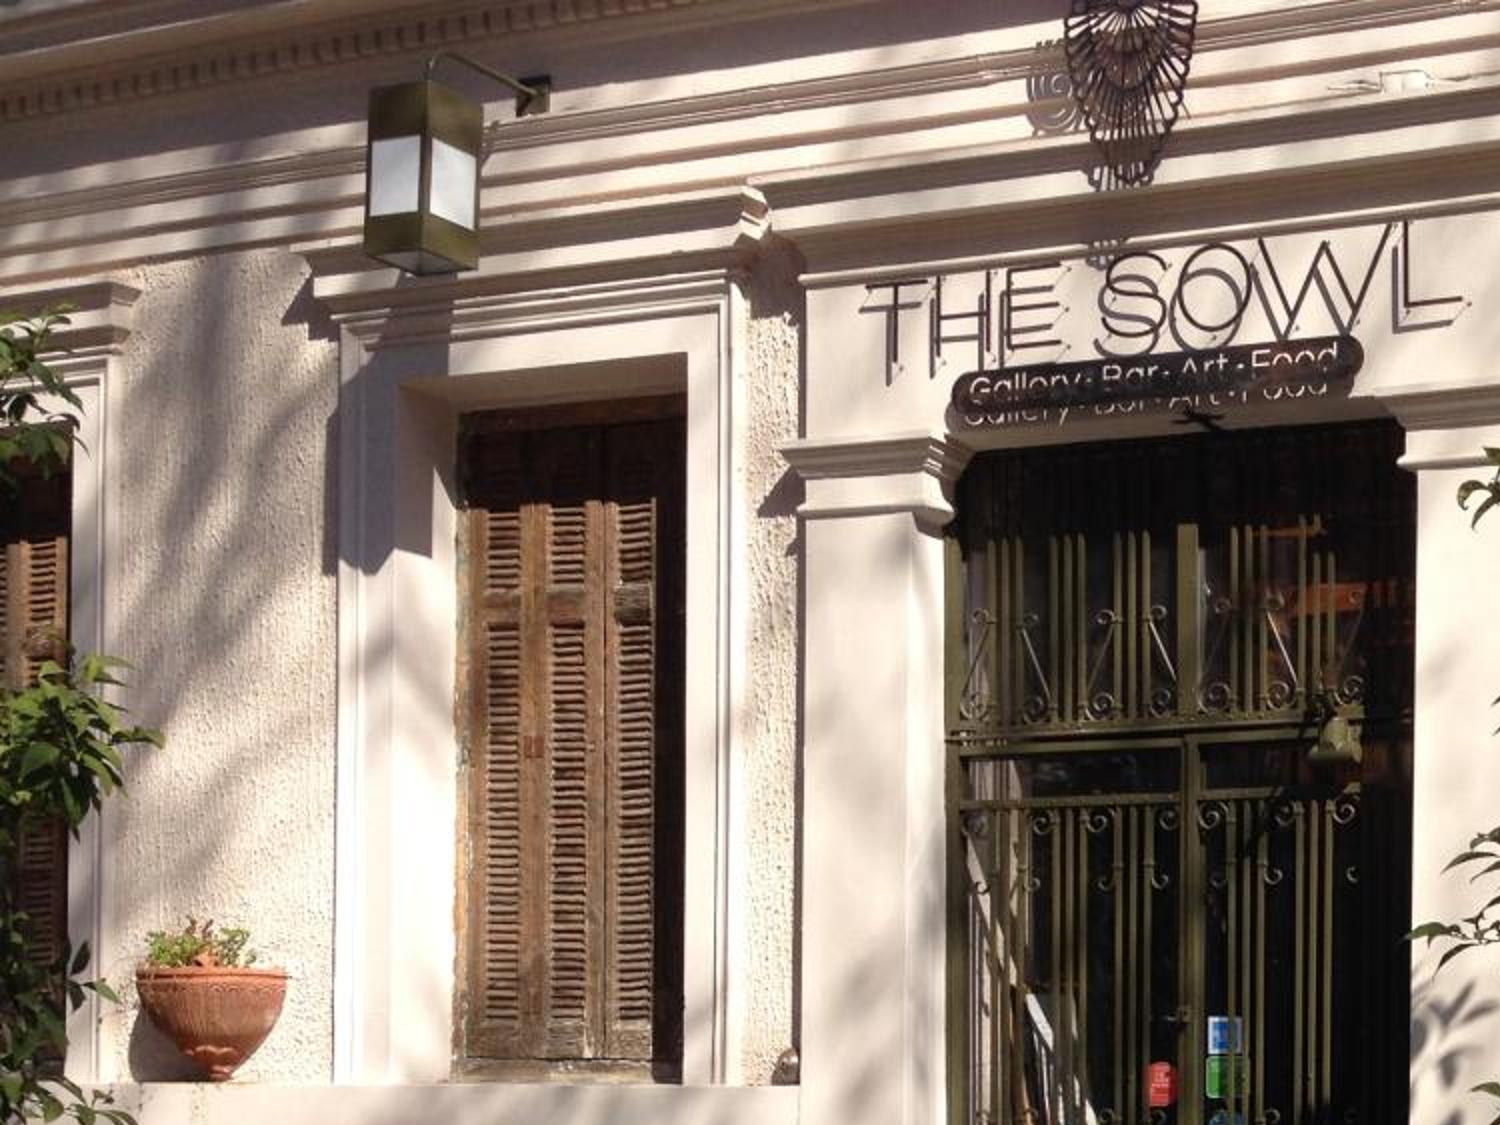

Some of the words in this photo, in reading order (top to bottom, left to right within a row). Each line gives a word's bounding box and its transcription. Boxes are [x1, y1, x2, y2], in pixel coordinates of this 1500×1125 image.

[865, 261, 1063, 363] THE
[1101, 219, 1464, 338] SOWL
[1182, 352, 1229, 379] Art
[1251, 341, 1339, 375] Food
